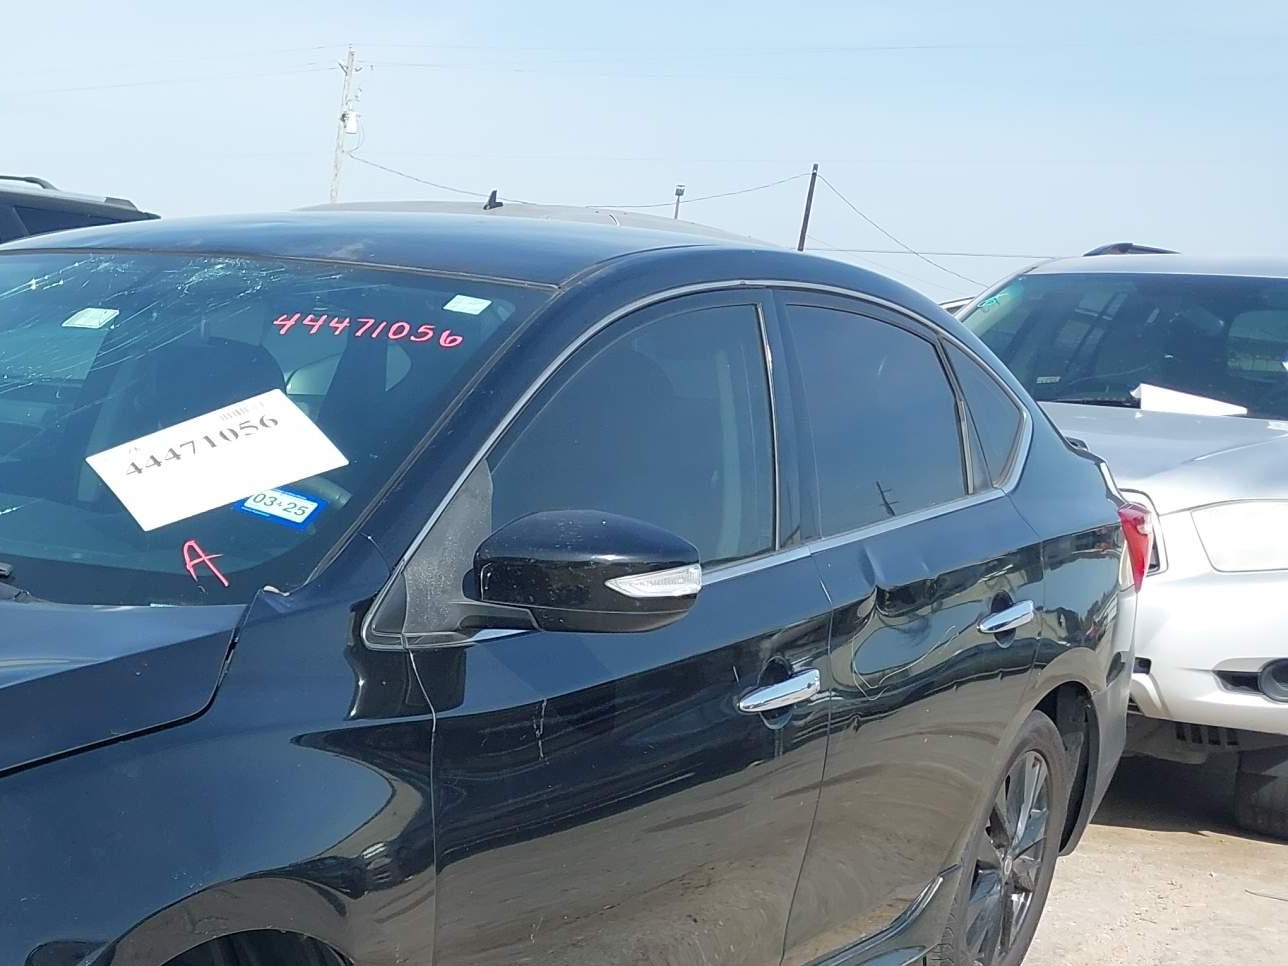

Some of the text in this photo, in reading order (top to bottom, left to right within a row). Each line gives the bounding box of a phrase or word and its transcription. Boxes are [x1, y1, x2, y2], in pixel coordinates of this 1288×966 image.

[273, 312, 464, 347] 44471056
[126, 415, 279, 476] 44471056
[252, 493, 310, 516] 03 25
[182, 539, 229, 588] A
